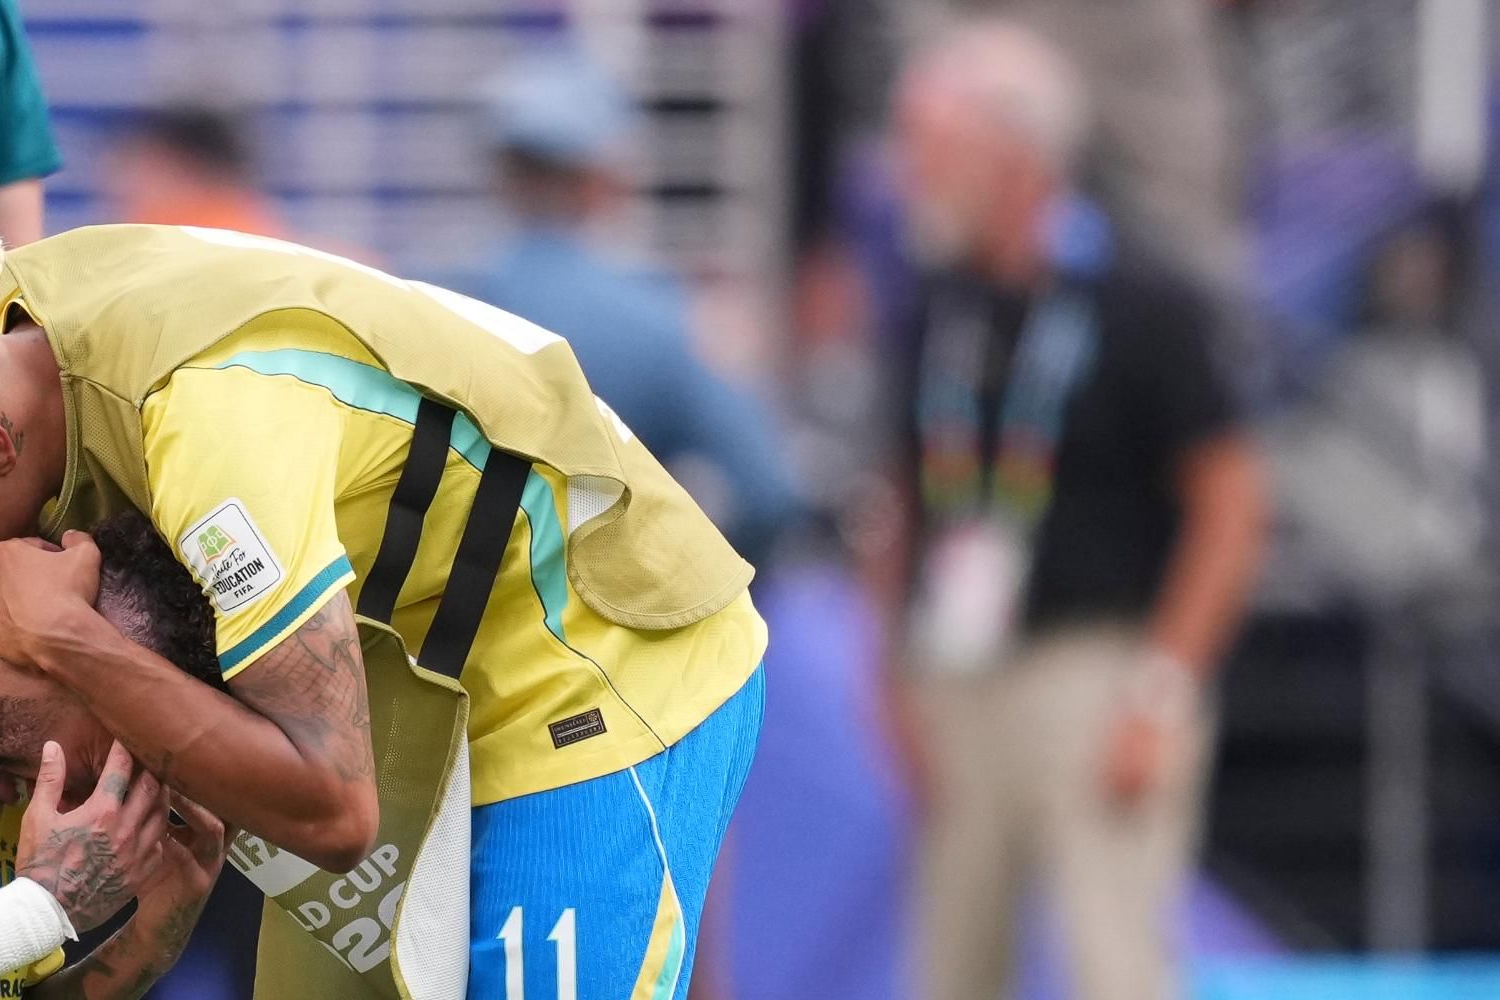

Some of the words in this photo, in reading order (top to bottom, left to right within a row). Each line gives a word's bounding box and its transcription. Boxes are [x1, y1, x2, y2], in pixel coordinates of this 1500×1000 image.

[212, 557, 266, 595] EDUCATION
[234, 584, 254, 599] FIFA
[328, 843, 400, 910] CUP
